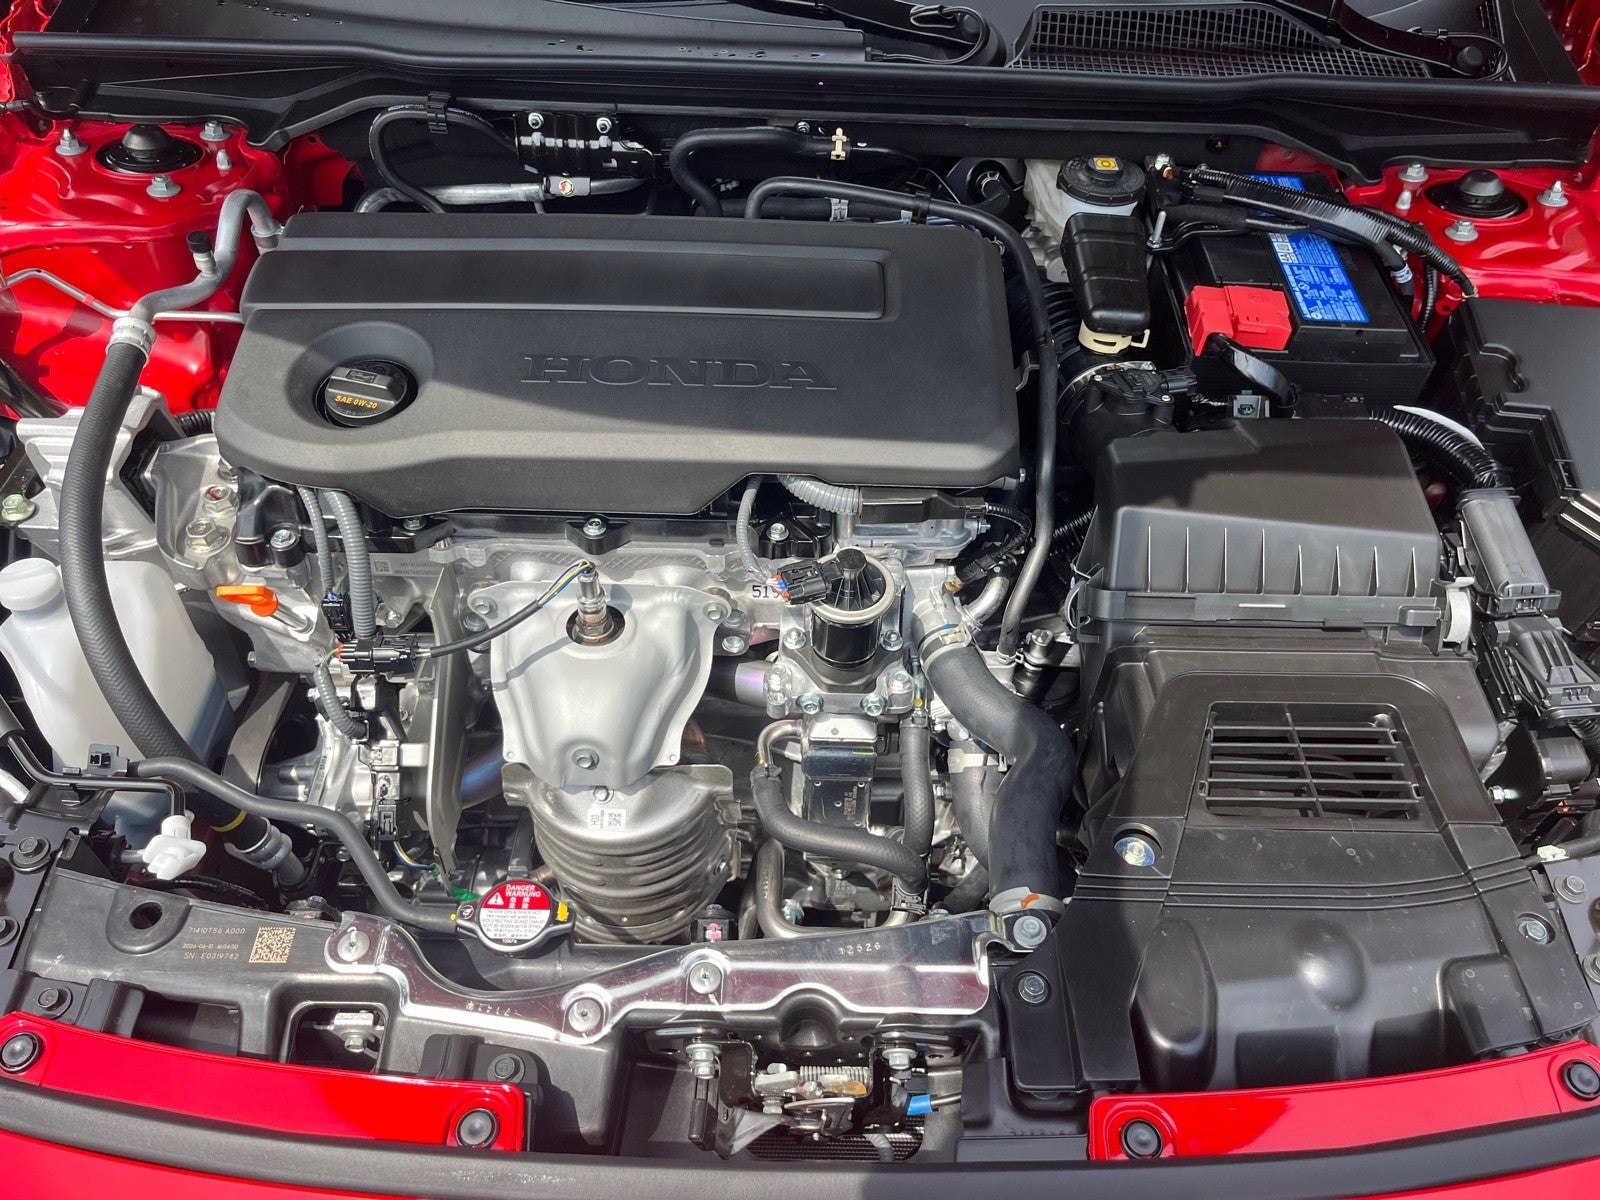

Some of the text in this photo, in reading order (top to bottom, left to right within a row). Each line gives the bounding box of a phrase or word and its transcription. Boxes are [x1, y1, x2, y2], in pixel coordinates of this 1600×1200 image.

[521, 354, 837, 390] HONDA
[335, 395, 378, 409] SAE 0W-20
[224, 927, 246, 935] A000
